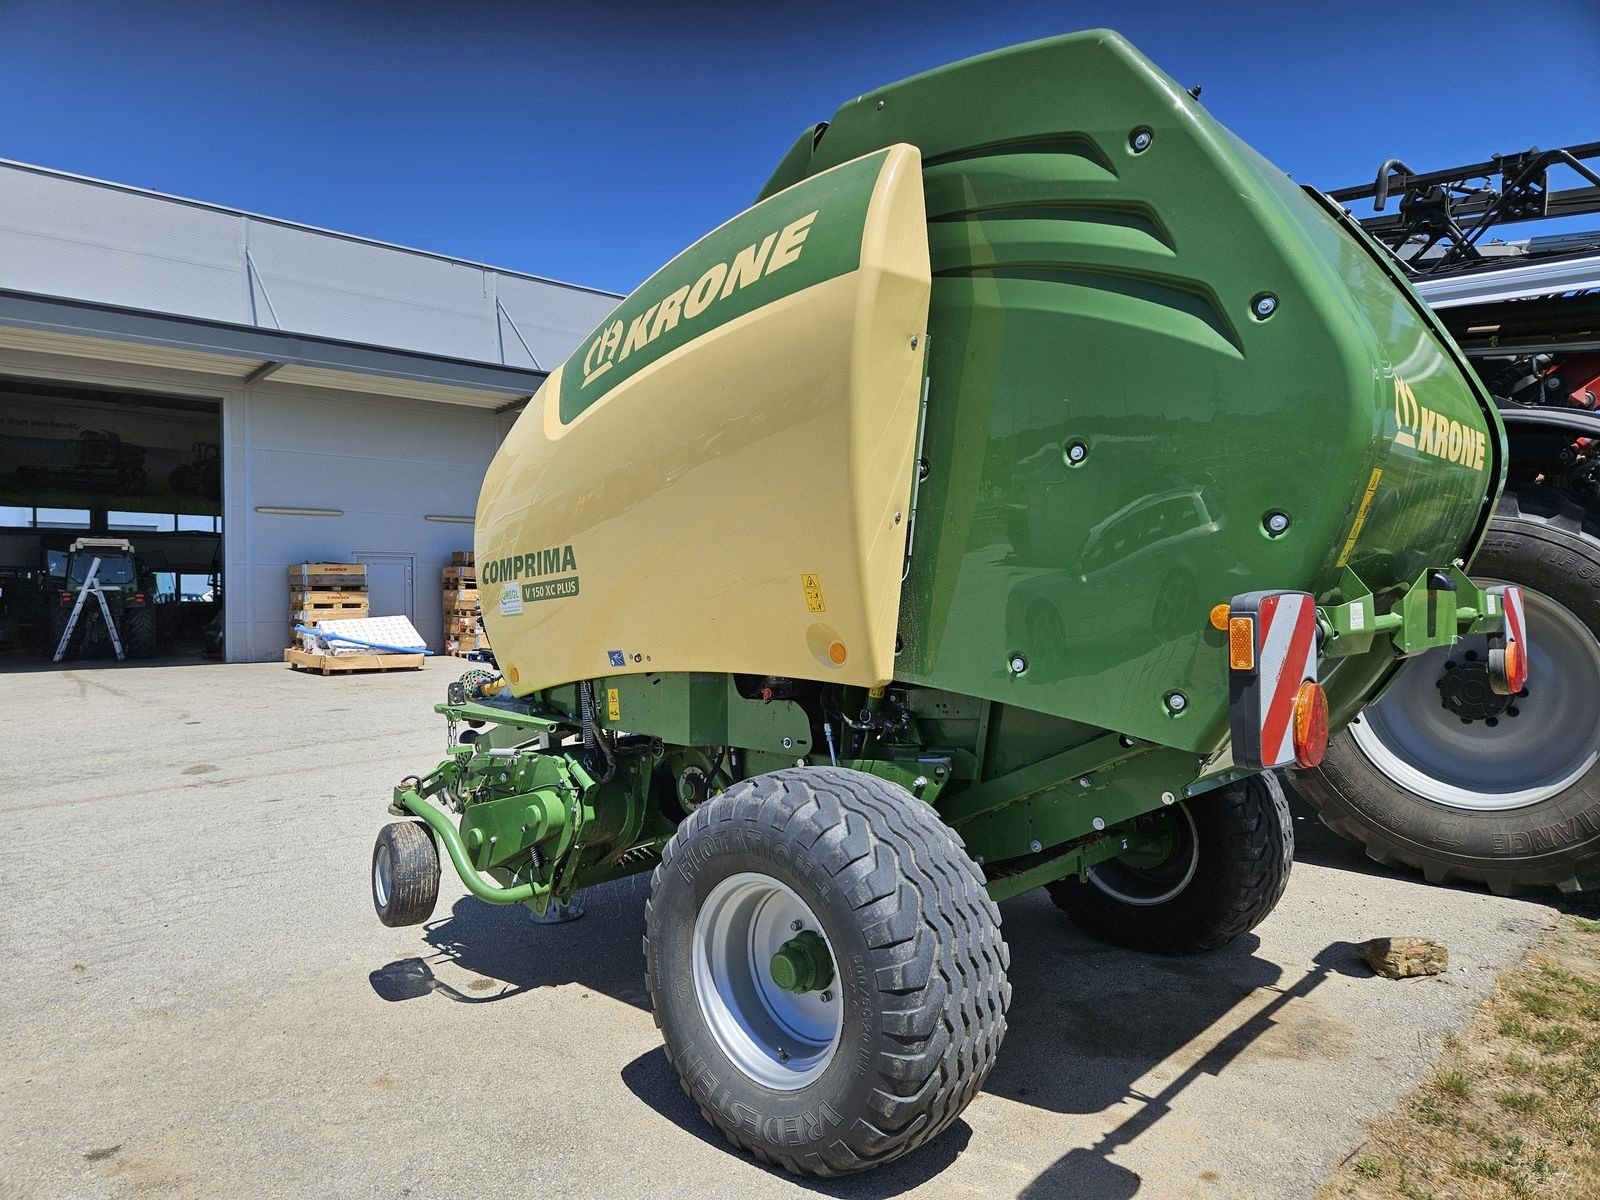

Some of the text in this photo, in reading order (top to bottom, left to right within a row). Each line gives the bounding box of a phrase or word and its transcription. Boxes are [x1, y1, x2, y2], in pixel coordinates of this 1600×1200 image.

[617, 209, 819, 363] KRONE
[1417, 406, 1486, 472] KRONE
[482, 544, 577, 586] COMPRIMA
[525, 587, 531, 599] V
[531, 586, 544, 598] 150
[545, 584, 556, 596] XC
[556, 581, 576, 595] PLUS
[676, 827, 813, 887] FLOTATION
[678, 1040, 845, 1147] VREDESTEIN
